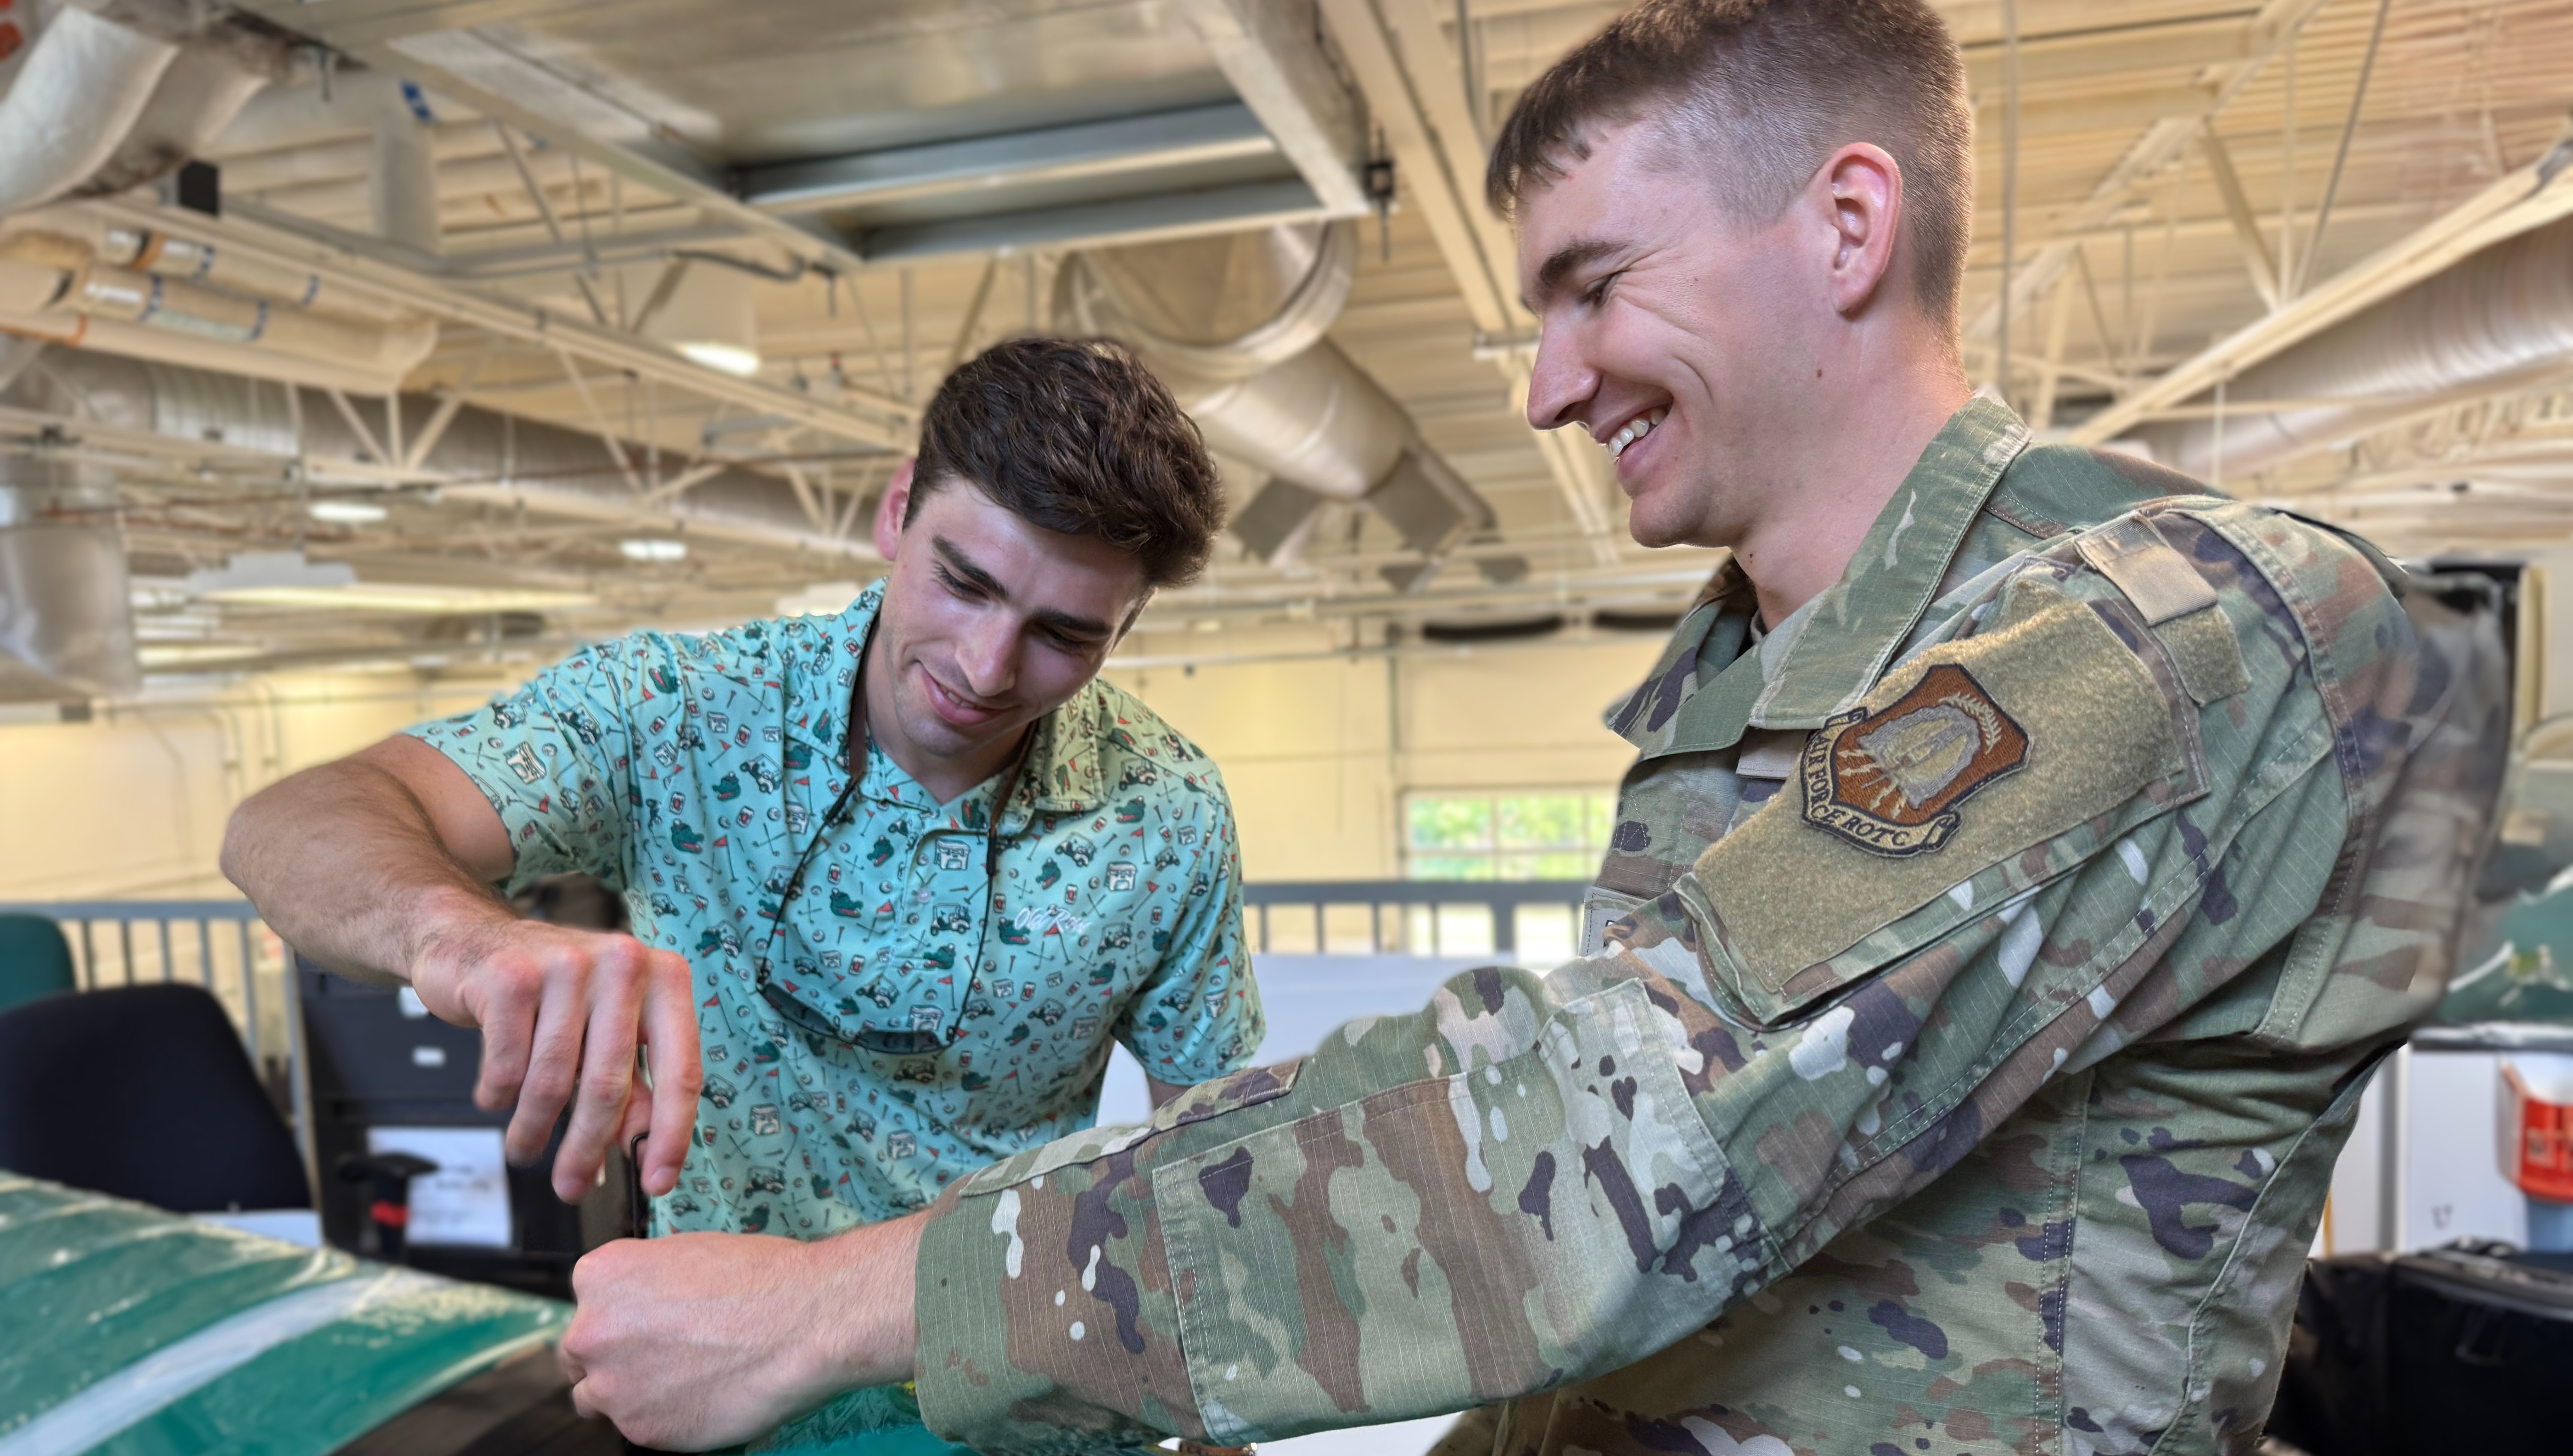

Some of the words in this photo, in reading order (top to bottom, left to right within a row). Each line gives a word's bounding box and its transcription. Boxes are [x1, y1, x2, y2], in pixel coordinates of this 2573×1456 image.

[1808, 735, 1832, 767] AIR
[1808, 766, 1846, 824] FORCE
[1842, 815, 1910, 846] ROTC
[1013, 907, 1052, 930] Old
[1046, 907, 1091, 934] Row
